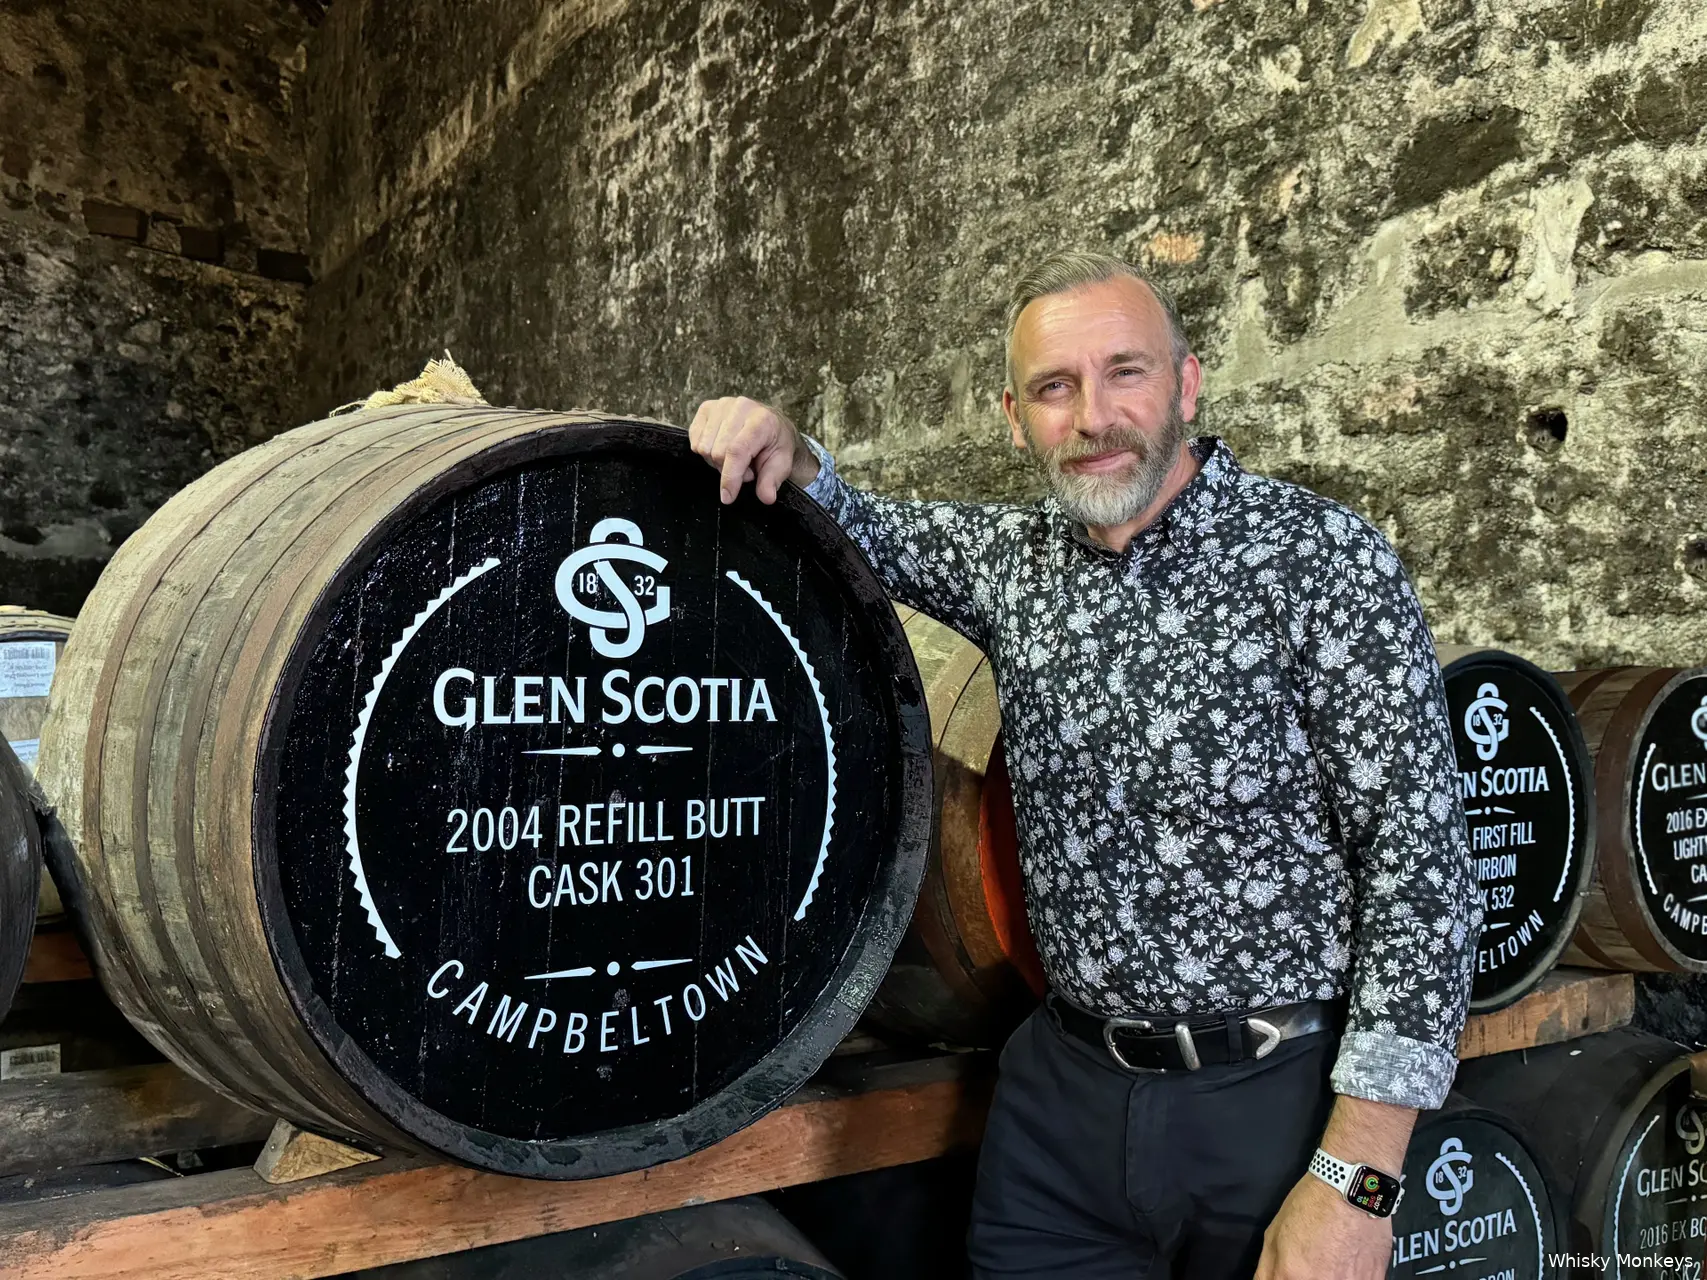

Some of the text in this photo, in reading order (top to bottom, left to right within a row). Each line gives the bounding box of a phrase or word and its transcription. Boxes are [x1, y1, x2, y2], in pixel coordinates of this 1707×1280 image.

[578, 572, 655, 596] 18 32
[434, 668, 778, 733] GLEN SCOTIA
[1472, 713, 1503, 727] 18 32
[1481, 765, 1550, 798] SCOTIA
[1651, 762, 1707, 793] GLEN
[446, 796, 766, 853] 2004 REFILL BUTT
[1472, 821, 1537, 851] FIRST FILL
[1665, 808, 1693, 834] 2016
[1673, 834, 1707, 861] LIGHT
[529, 856, 694, 908] CASK 301
[1491, 884, 1515, 910] 532
[427, 934, 769, 1054] CAMPBELTOWN
[1435, 1165, 1467, 1184] 18 32
[1637, 1167, 1684, 1198] GLEN
[1393, 1208, 1518, 1268] LEN SCOTIA
[1640, 1223, 1669, 1250] 2016
[1672, 1219, 1687, 1241] EX
